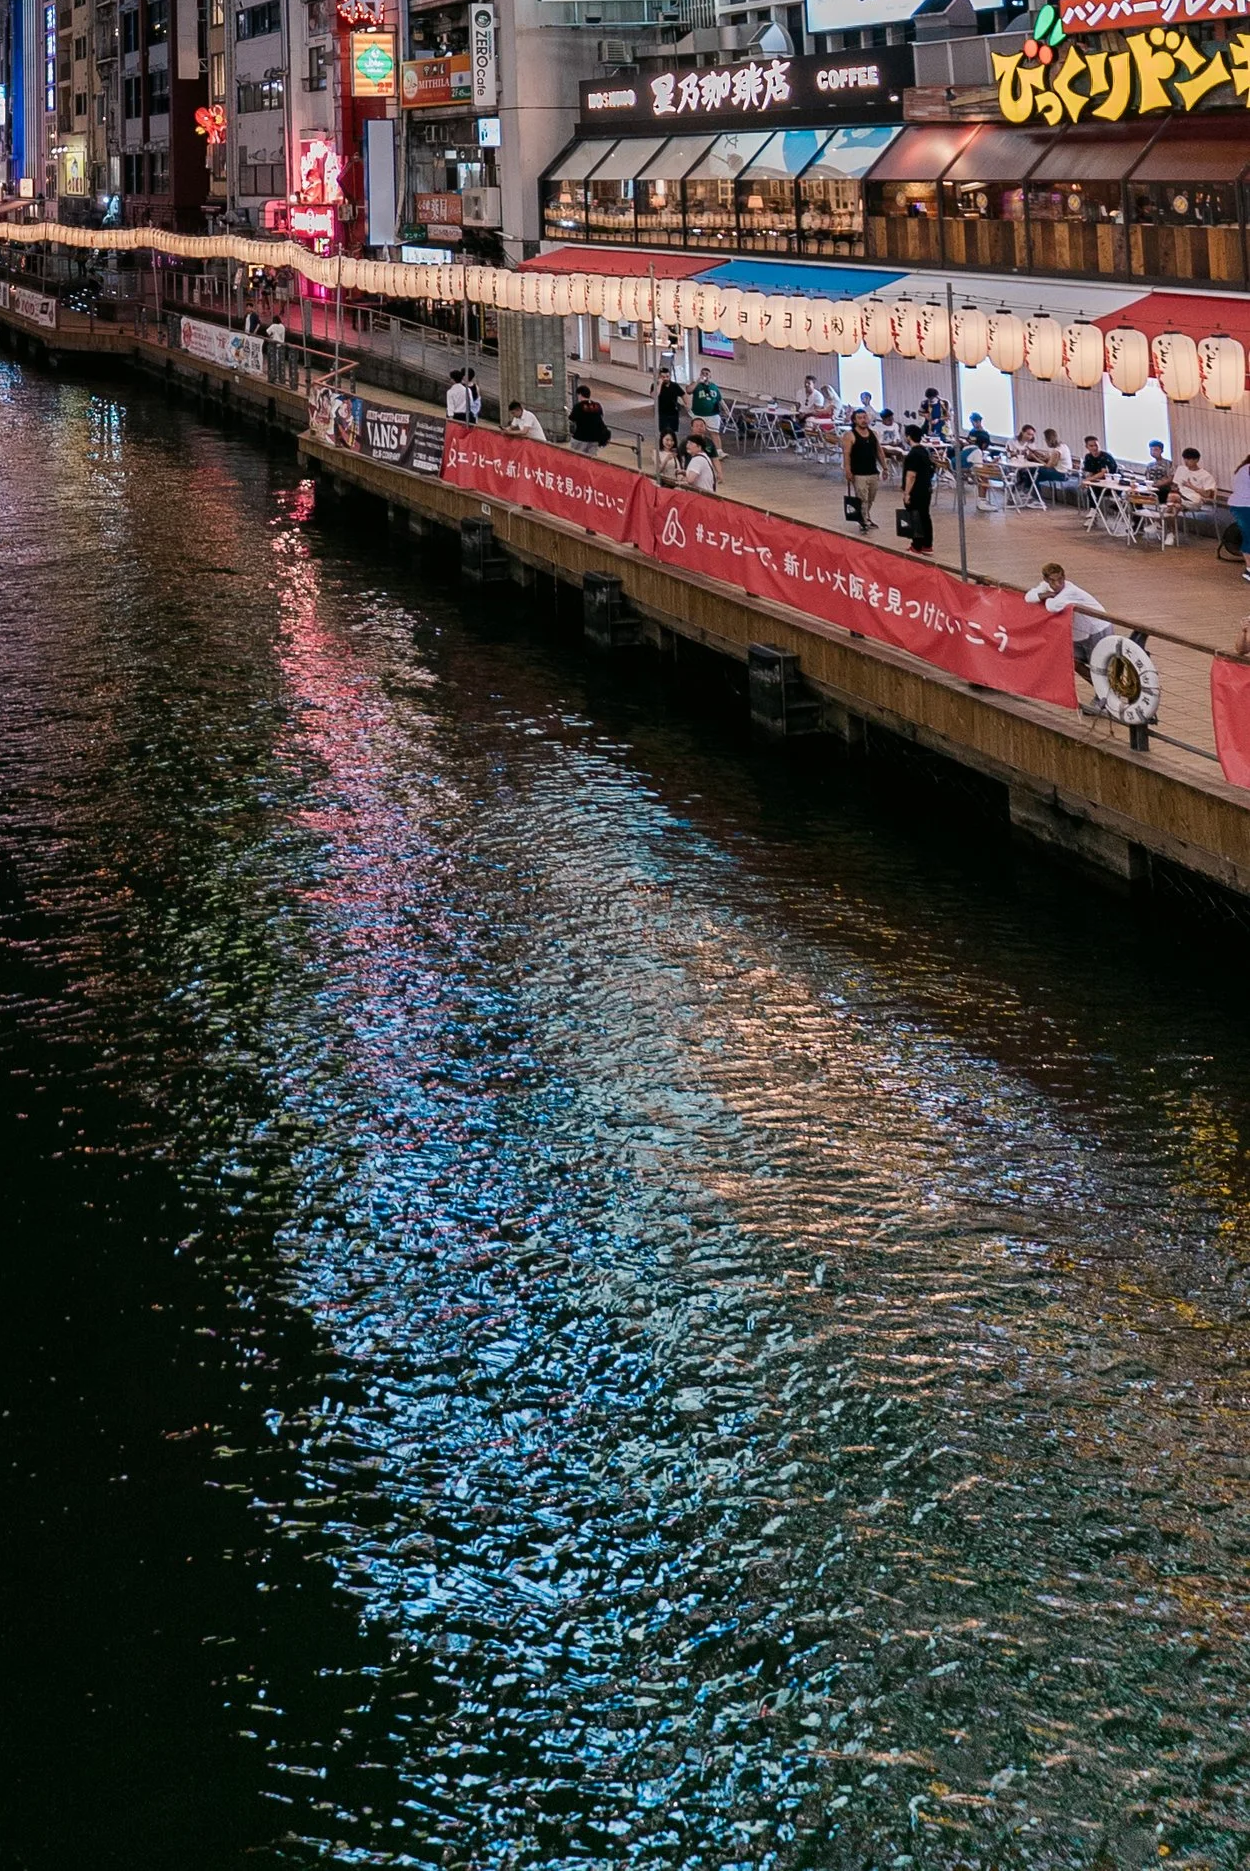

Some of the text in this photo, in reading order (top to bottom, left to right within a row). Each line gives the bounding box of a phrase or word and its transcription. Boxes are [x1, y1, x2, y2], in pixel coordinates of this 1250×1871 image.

[418, 77, 450, 89] MITHILA
[650, 59, 791, 116] 星乃珈琲店
[816, 65, 880, 91] COFFEE
